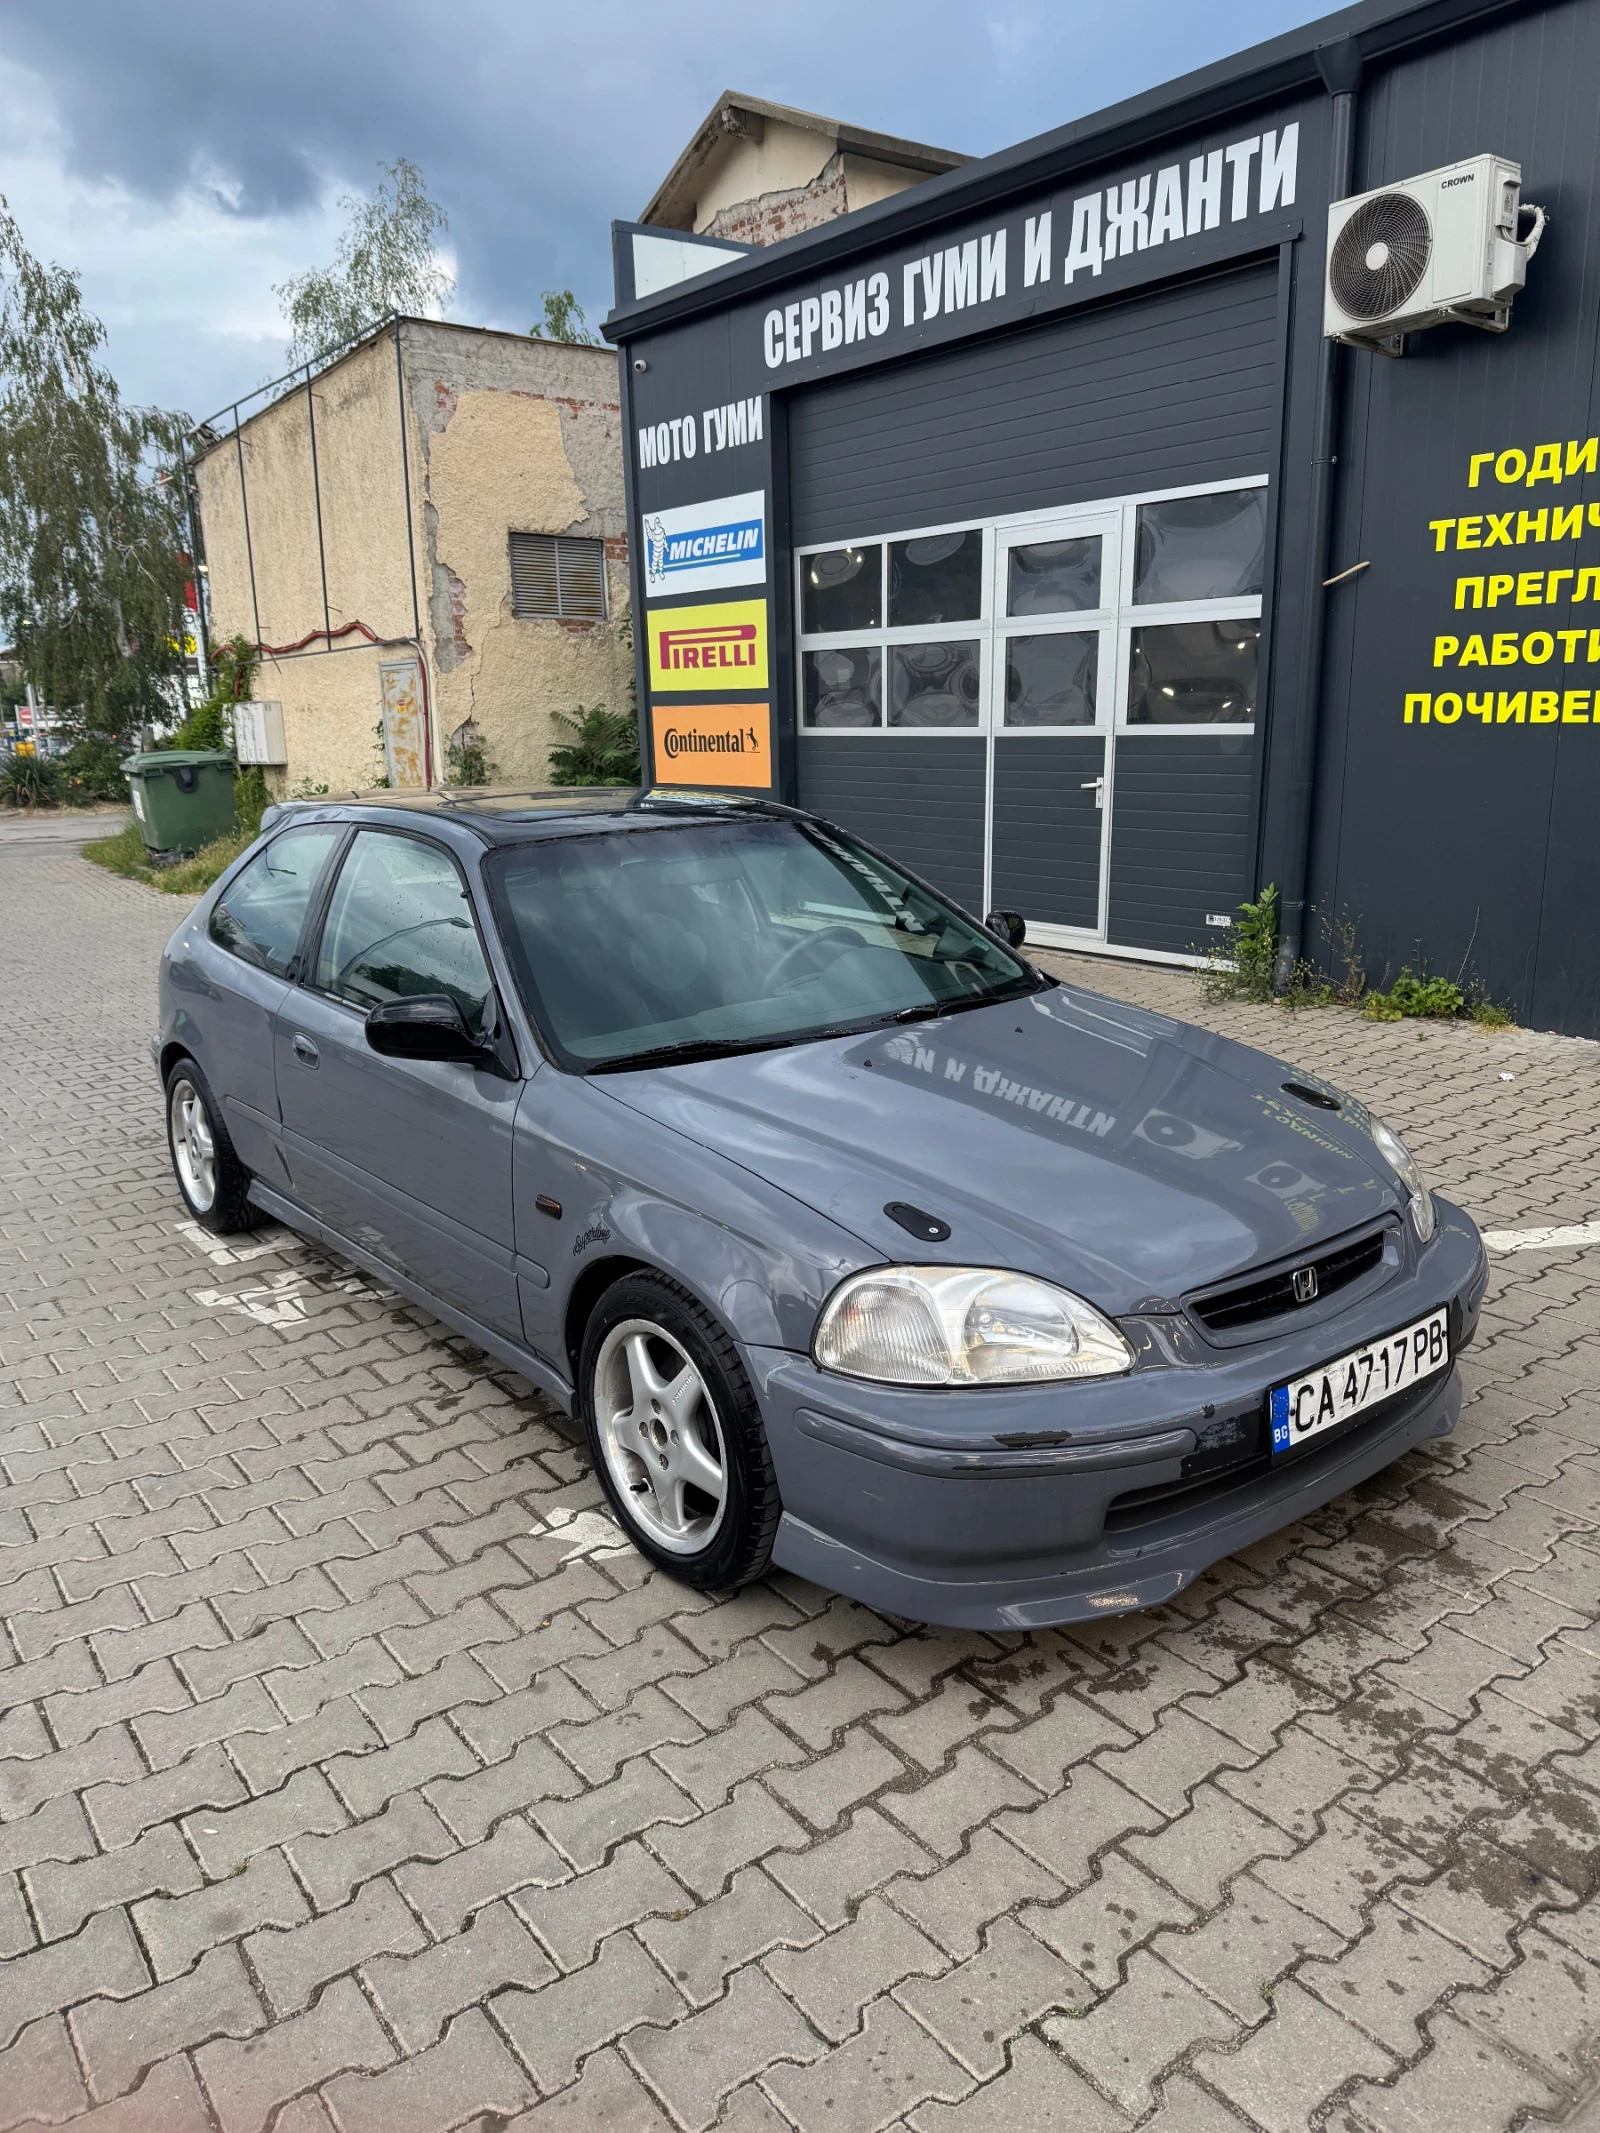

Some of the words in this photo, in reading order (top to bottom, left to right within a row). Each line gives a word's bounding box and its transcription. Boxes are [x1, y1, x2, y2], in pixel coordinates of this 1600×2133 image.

[1441, 173, 1475, 189] CROWN
[764, 272, 890, 368] СЕРВИЗ
[904, 228, 1006, 327] ГУМИ
[1023, 216, 1052, 287] И
[1064, 122, 1300, 284] ДЖАНТИ
[638, 415, 697, 469] МОТО
[703, 395, 763, 453] ГУМИ
[1468, 437, 1599, 488] ГОДИ
[669, 528, 759, 560] MICHELIN
[659, 624, 757, 669] PIRELLI
[1403, 690, 1600, 724] ПОЧИВЕ
[664, 728, 745, 758] Continental
[1294, 1381, 1335, 1432] CA
[1343, 1337, 1408, 1407] 4717
[1413, 1319, 1442, 1375] PB
[1274, 1425, 1289, 1443] BG
